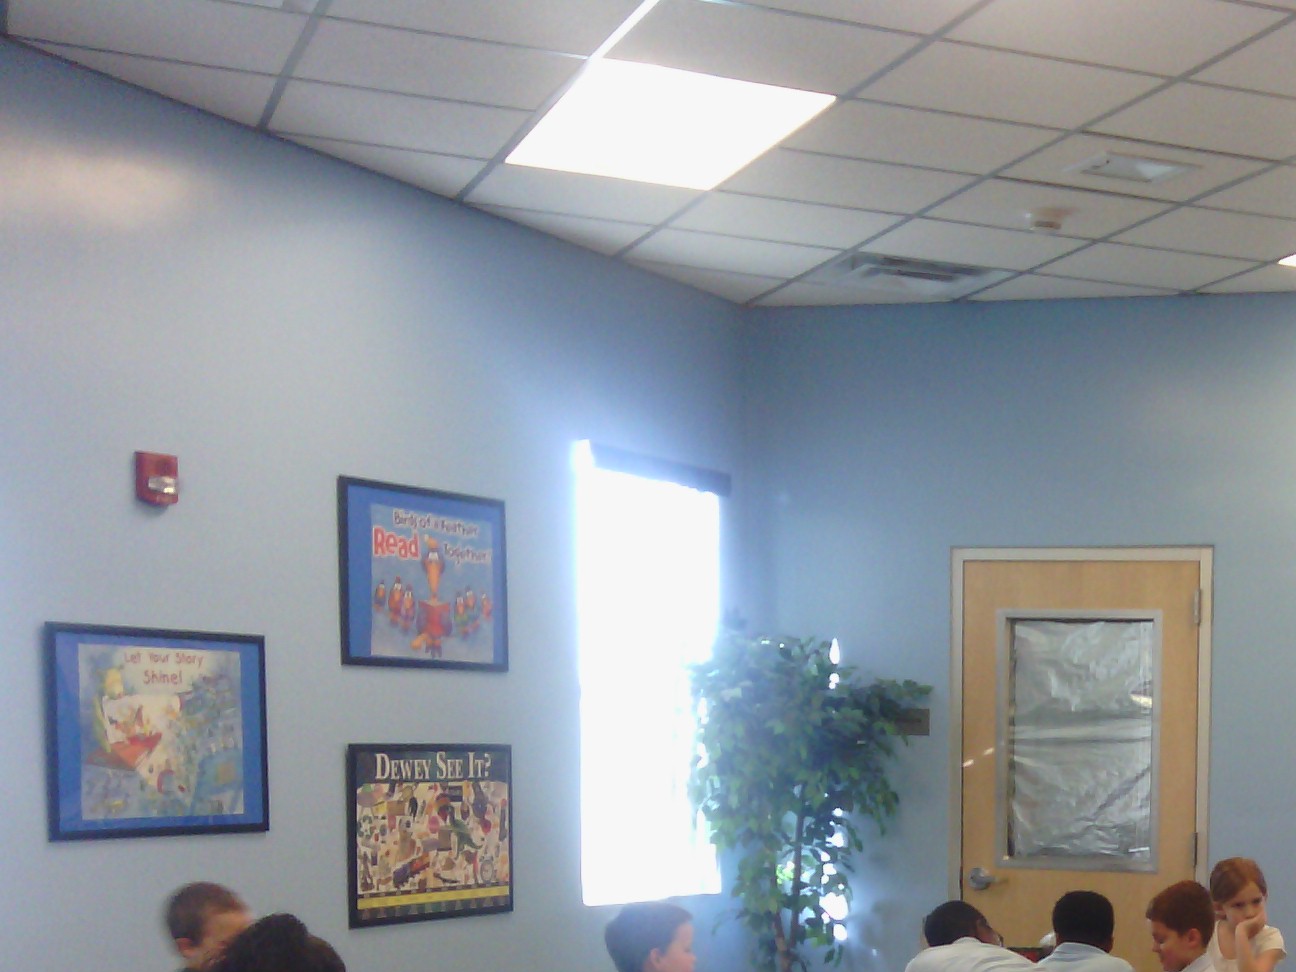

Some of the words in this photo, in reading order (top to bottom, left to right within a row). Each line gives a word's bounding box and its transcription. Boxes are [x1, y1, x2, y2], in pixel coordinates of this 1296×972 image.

[373, 526, 420, 559] Read
[124, 652, 141, 664] Let
[149, 652, 169, 664] Your
[176, 652, 204, 669] Story
[143, 669, 183, 685] Shine!
[375, 752, 432, 780] DEWEY
[436, 751, 463, 779] SEE
